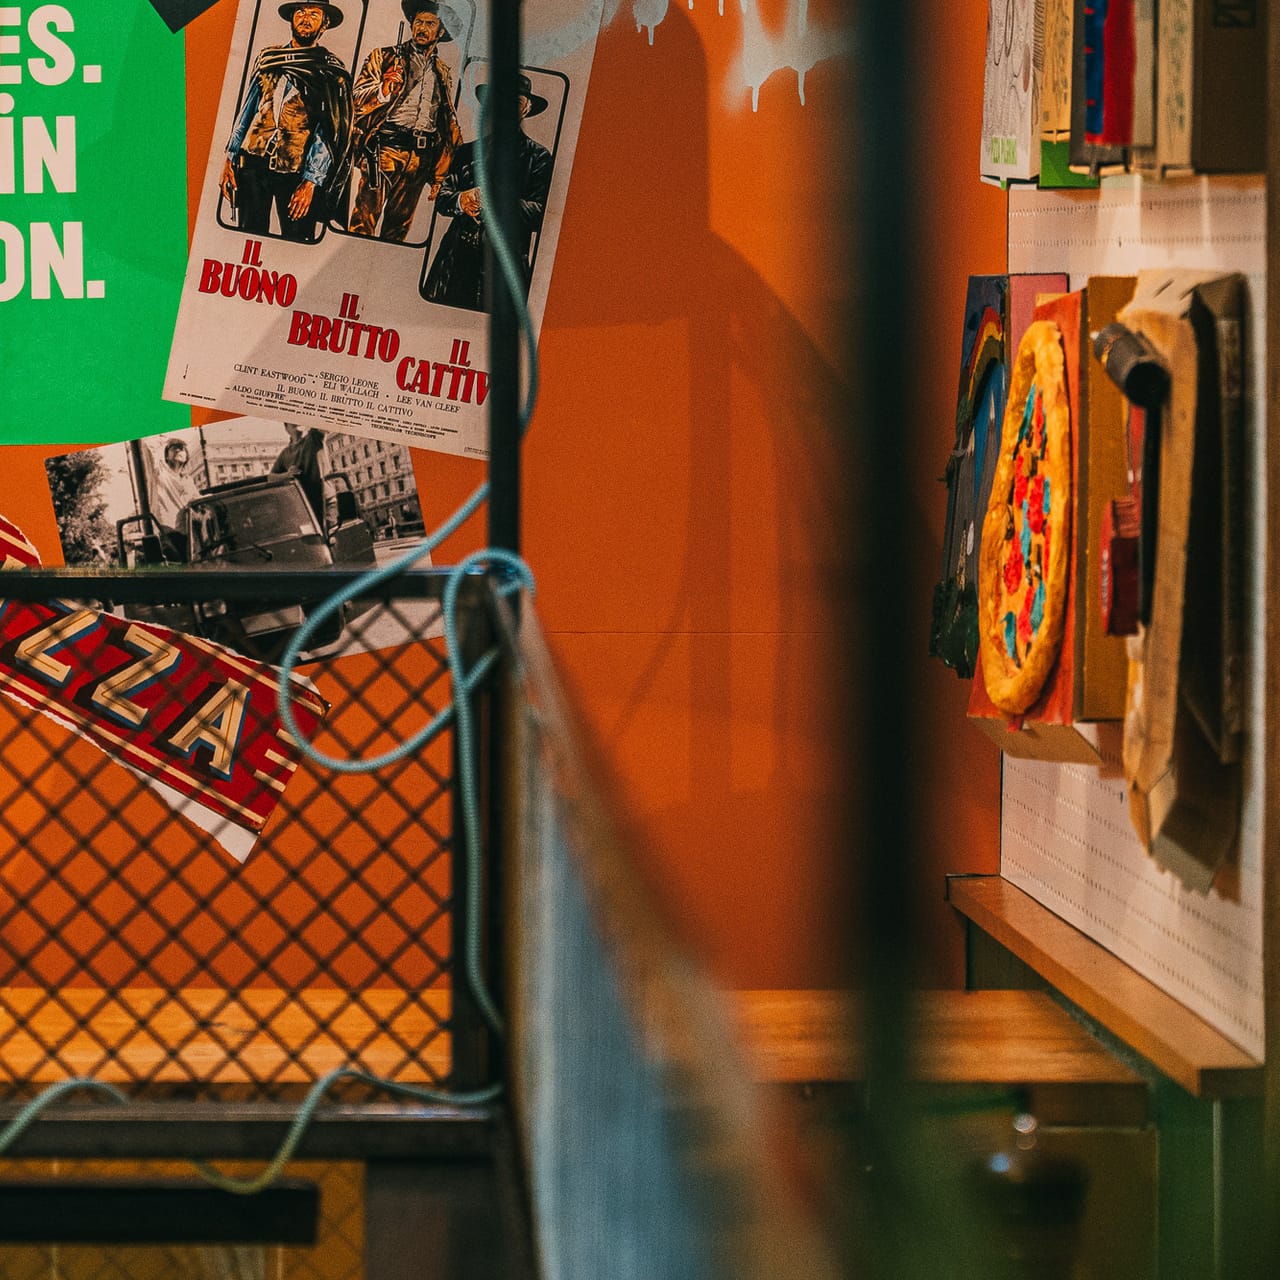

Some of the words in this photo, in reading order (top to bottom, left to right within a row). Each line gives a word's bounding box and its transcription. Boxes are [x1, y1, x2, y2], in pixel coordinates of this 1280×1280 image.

[241, 239, 263, 268] IL
[198, 258, 298, 308] BUONO
[338, 292, 361, 320] IL
[287, 310, 400, 363] BRUTTO
[448, 339, 471, 367] IL
[232, 384, 252, 394] ALDO
[233, 363, 259, 376] CLINT
[260, 368, 307, 385] EASTWOOD
[322, 380, 337, 391] ELI
[339, 383, 380, 399] WALLACH
[396, 394, 413, 405] LEE
[415, 398, 433, 409] VAN
[434, 401, 461, 414] CLEEF
[319, 370, 350, 384] SERGIO
[351, 377, 380, 390] LEONE
[396, 356, 490, 406] CATTIV
[276, 384, 285, 393] IL
[287, 386, 317, 399] BUONO
[319, 392, 329, 401] IL
[331, 394, 364, 408] BRUTTO
[365, 401, 375, 410] IL
[377, 403, 414, 418] CATTIVO
